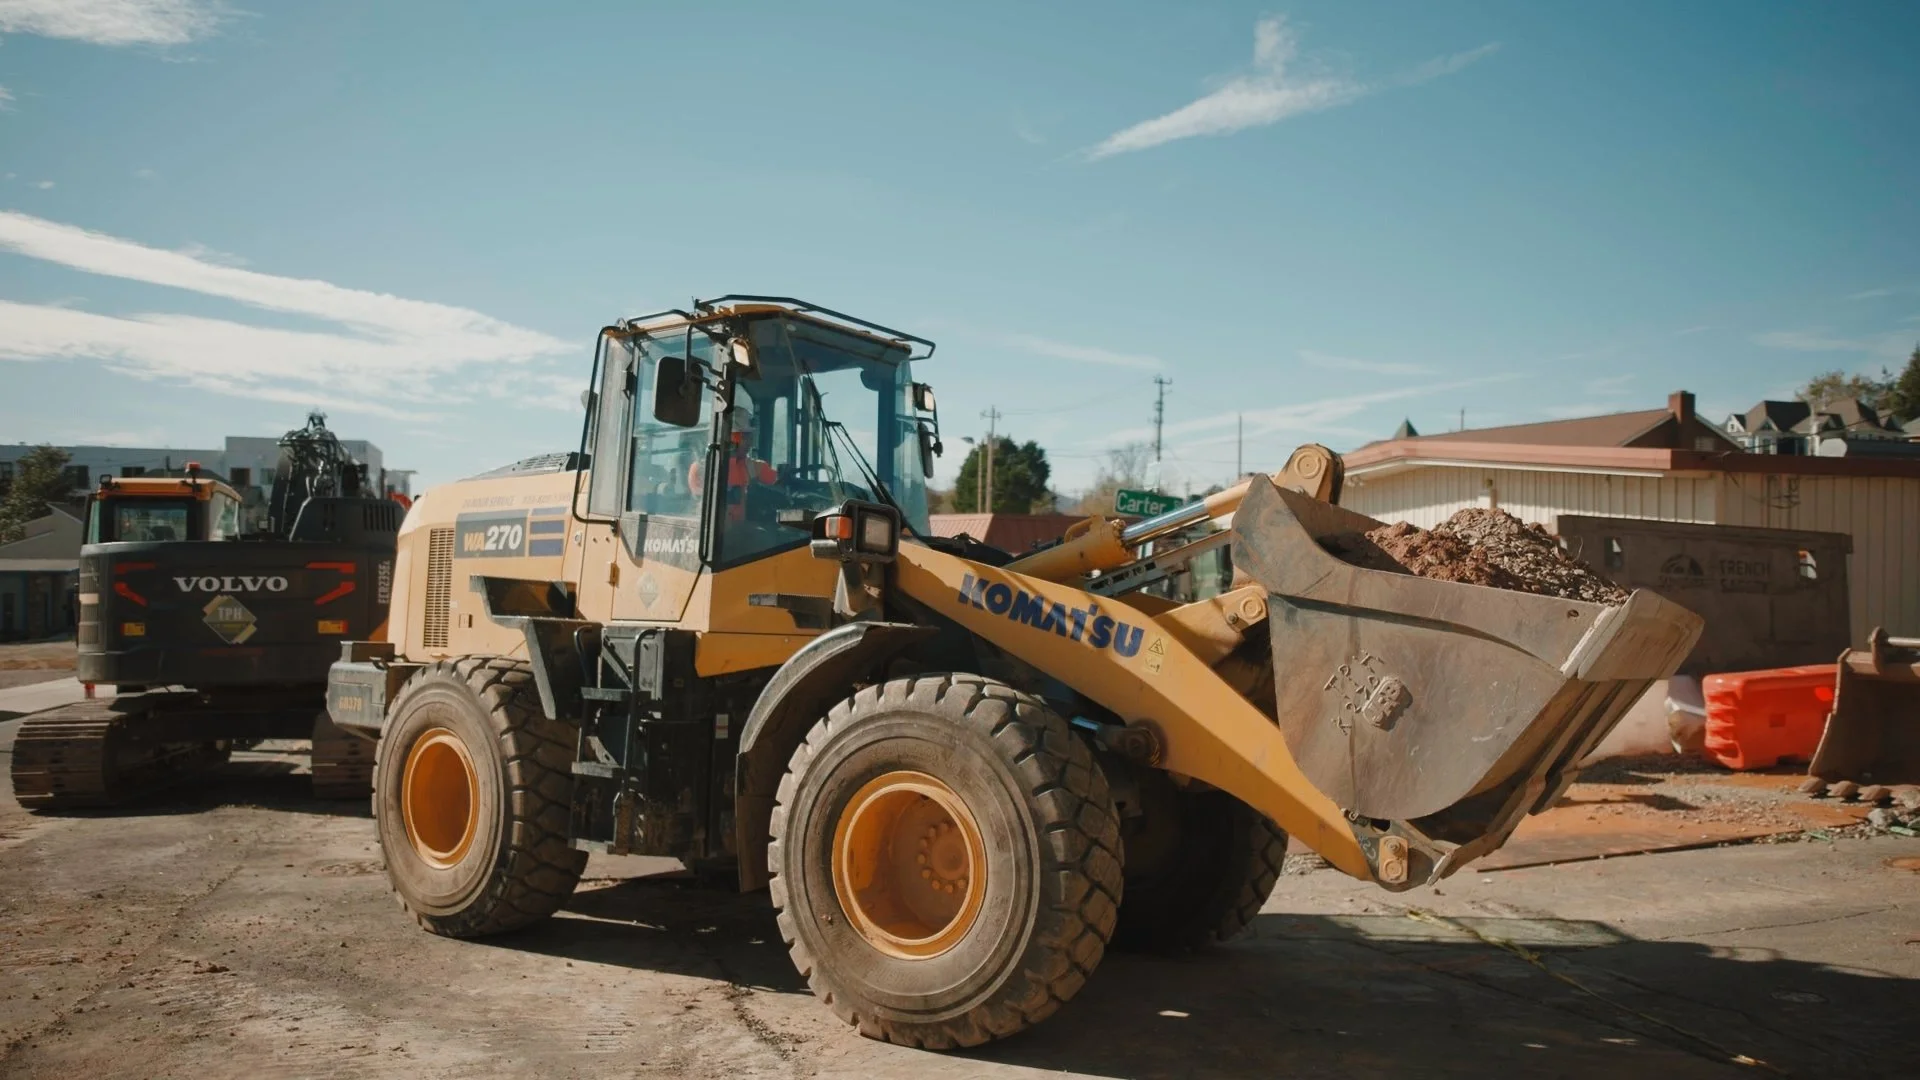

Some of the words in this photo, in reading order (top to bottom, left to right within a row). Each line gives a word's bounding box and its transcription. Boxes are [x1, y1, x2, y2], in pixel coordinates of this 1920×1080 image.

[1116, 492, 1167, 515] Carter
[172, 576, 289, 592] VOLVO
[217, 607, 243, 621] TPH
[957, 573, 1145, 658] KOMATSU
